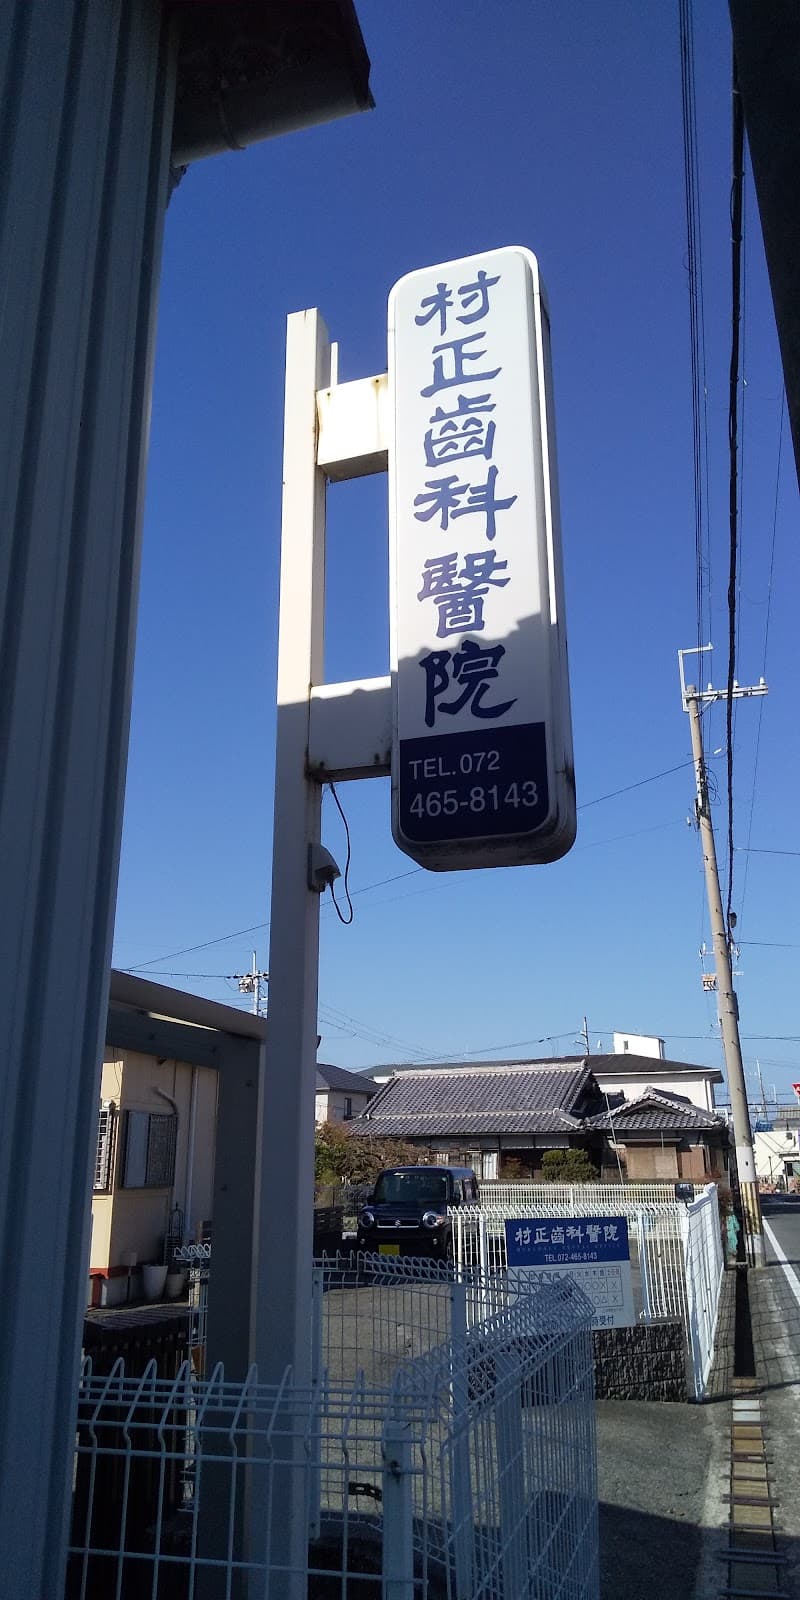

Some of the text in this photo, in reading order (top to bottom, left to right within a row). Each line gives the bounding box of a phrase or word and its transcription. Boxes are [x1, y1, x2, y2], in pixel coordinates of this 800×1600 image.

[413, 271, 518, 728] 村正齒科醫院
[409, 780, 539, 818] 465-8143
